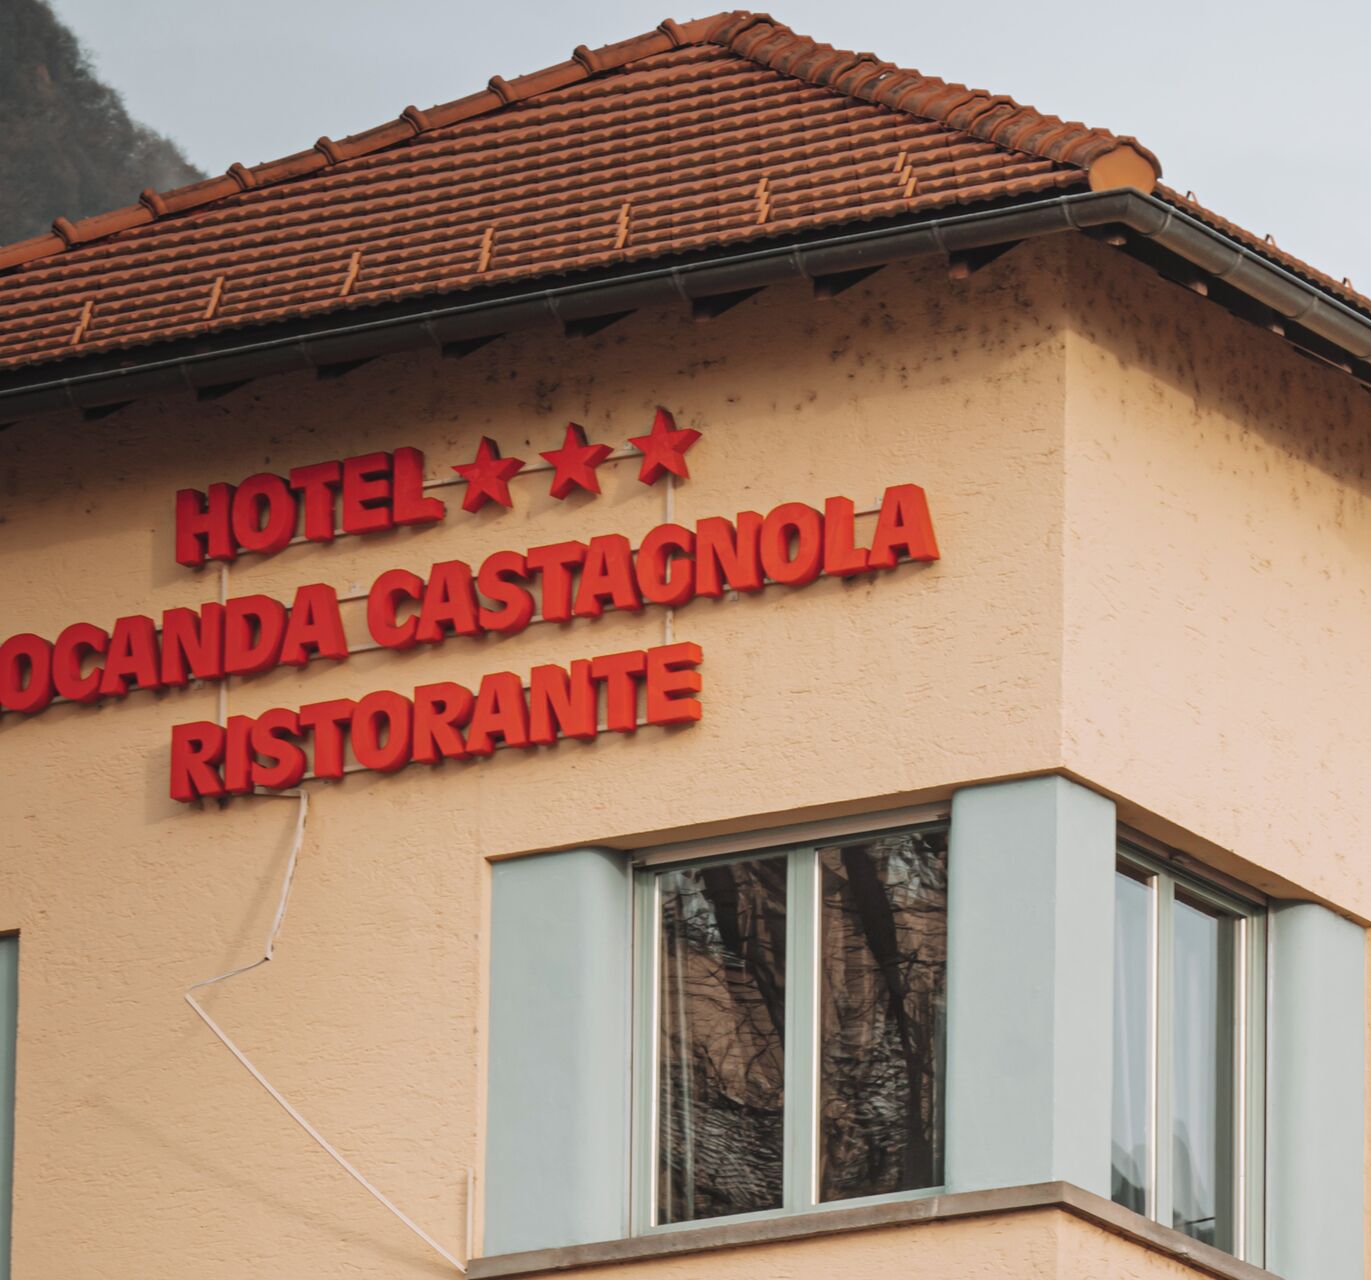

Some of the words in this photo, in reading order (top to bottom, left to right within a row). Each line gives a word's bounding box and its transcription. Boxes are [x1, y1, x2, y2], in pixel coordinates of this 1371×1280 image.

[176, 446, 446, 567] HOTEL
[366, 483, 940, 650] CASTAGNOLA
[170, 641, 702, 802] RISTORANTE
